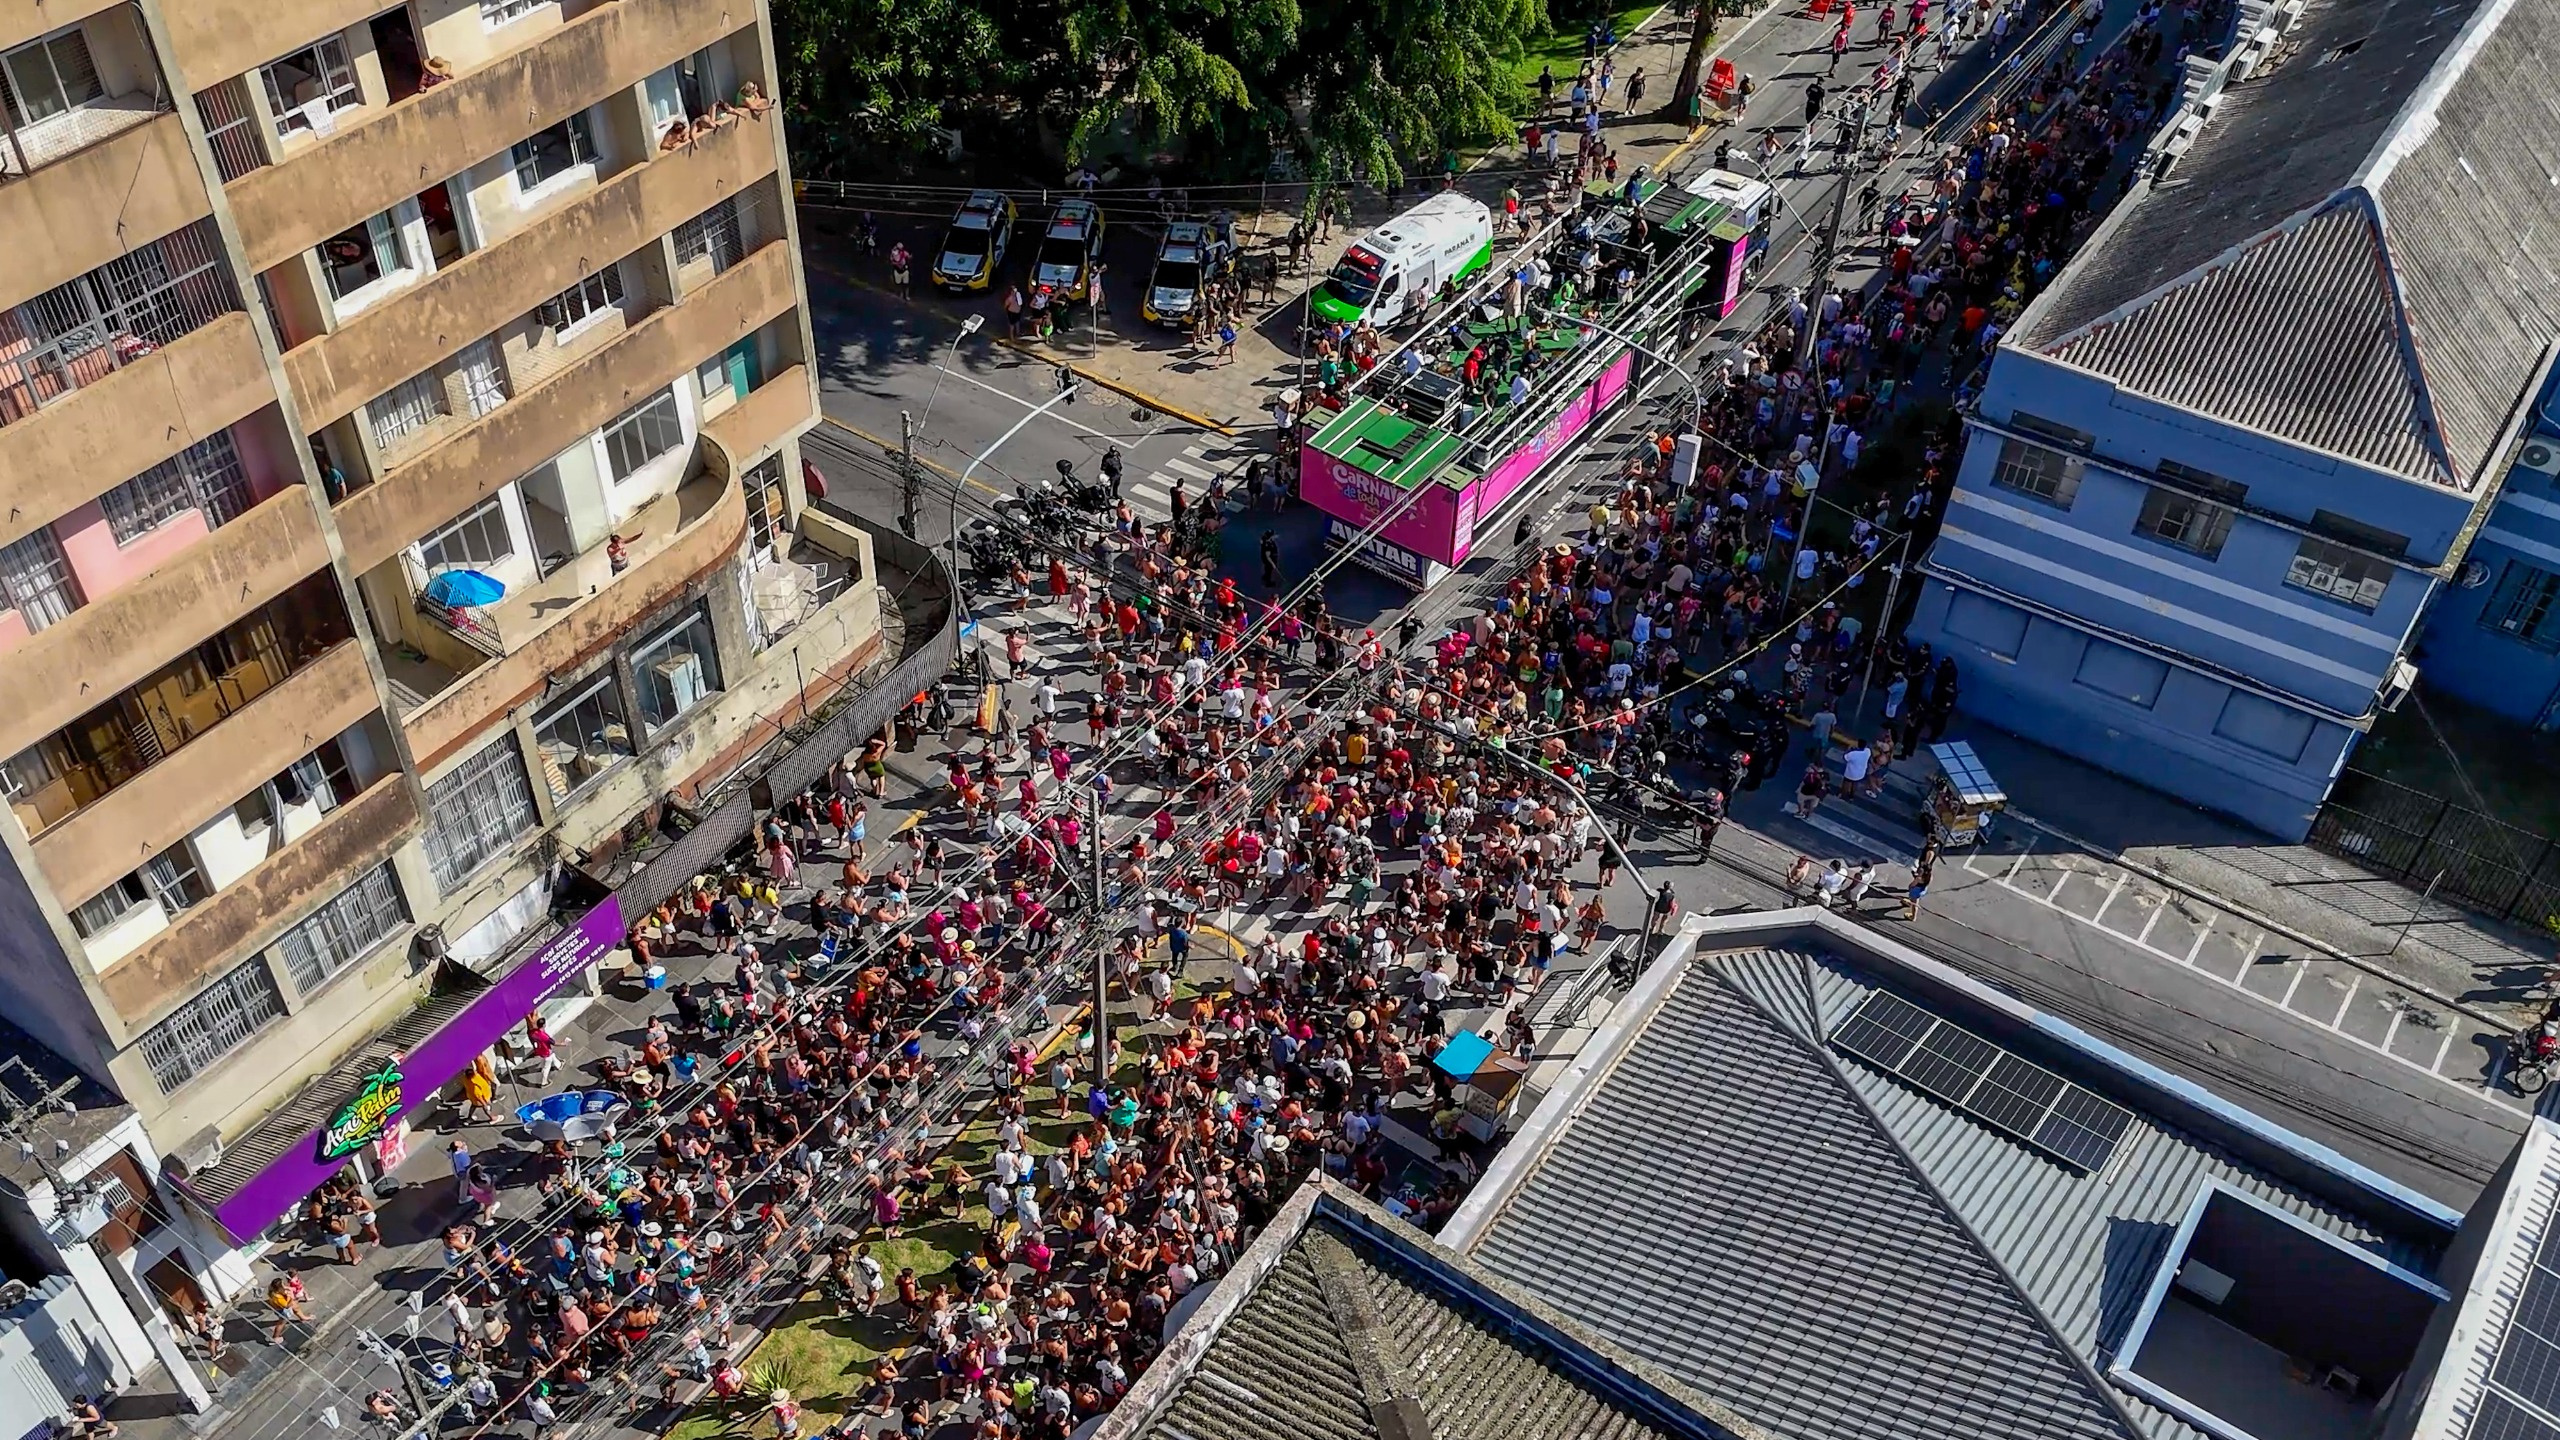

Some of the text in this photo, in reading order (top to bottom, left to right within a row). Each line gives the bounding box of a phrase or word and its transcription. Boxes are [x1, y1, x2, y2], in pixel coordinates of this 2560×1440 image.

[1331, 520, 1417, 571] AVATAR
[549, 939, 578, 964] SORVETES
[555, 927, 583, 950] TROPICAL
[540, 937, 590, 979] SUCOS NATURAIS
